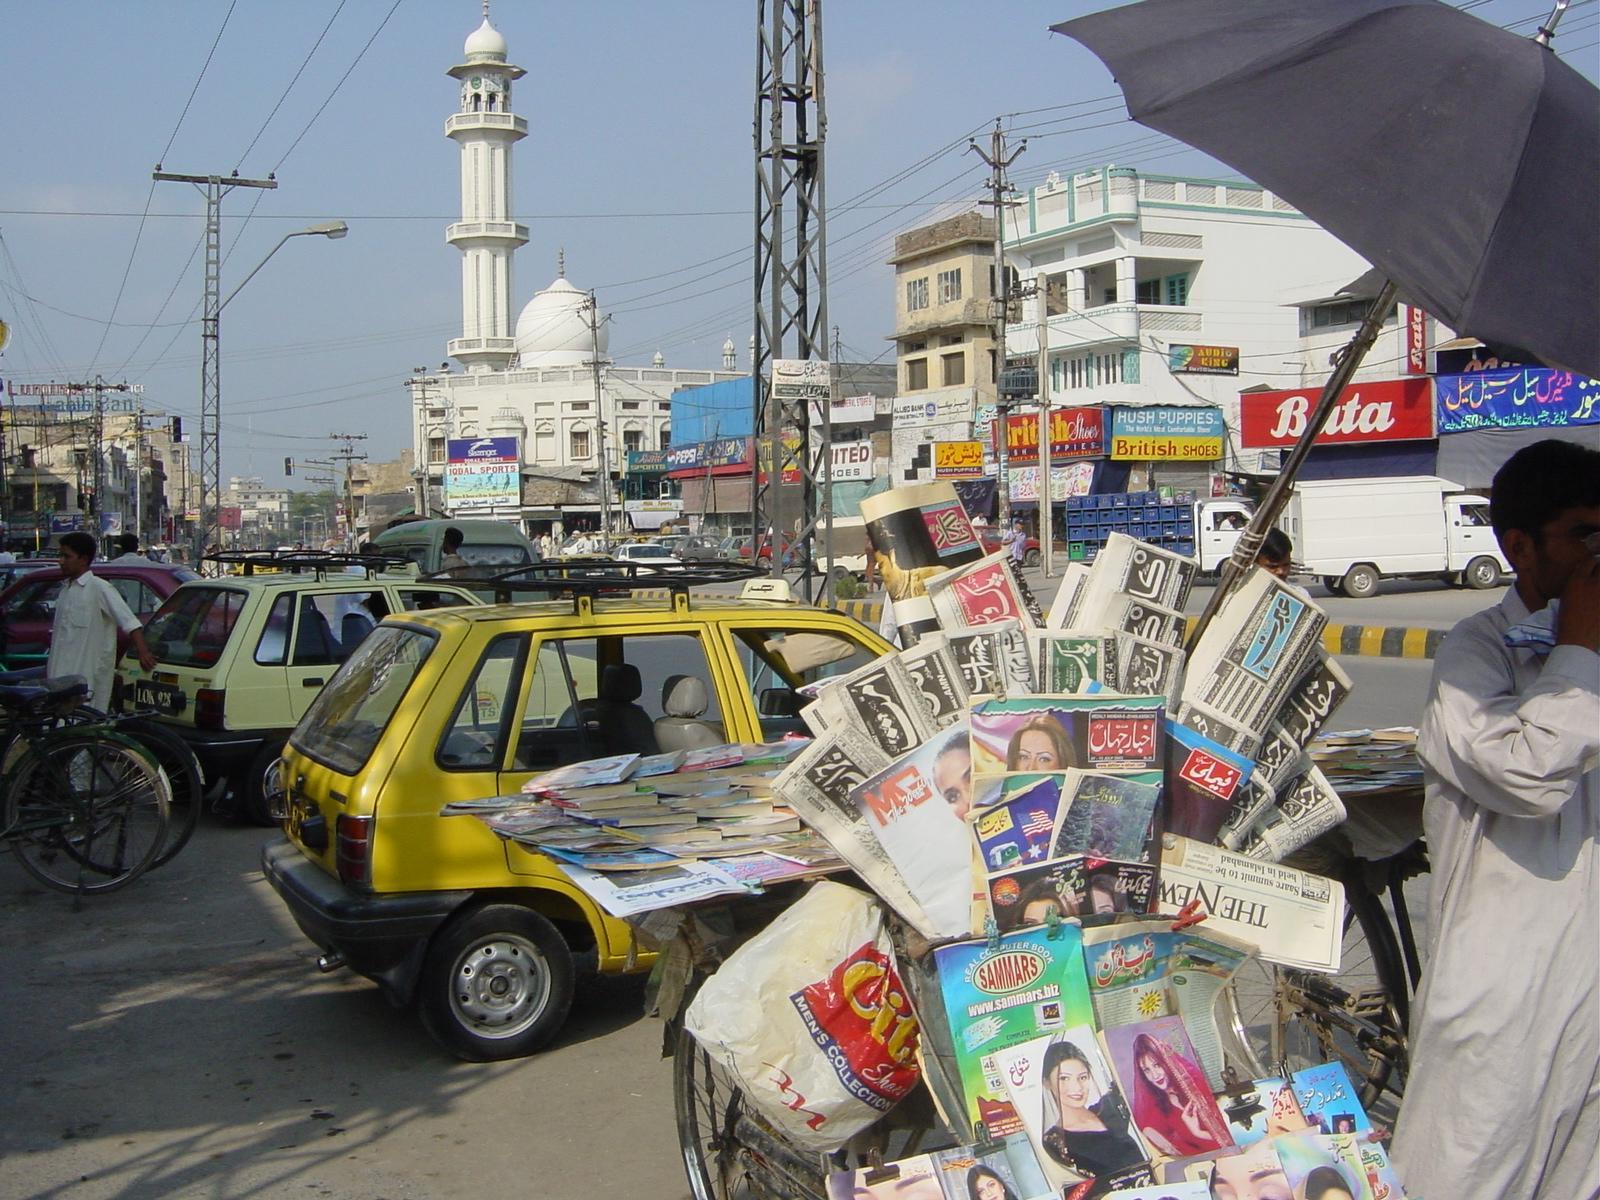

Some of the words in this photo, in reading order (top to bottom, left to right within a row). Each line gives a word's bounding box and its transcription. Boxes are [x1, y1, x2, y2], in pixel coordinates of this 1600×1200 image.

[1410, 308, 1424, 369] Bata
[1117, 411, 1155, 424] HUSH
[1159, 411, 1214, 425] PUPPIES
[993, 413, 1069, 447] ritsh
[1068, 412, 1099, 441] Shoes
[1116, 439, 1177, 456] British
[1183, 445, 1218, 456] SHOES
[676, 448, 697, 465] PEPSI
[449, 467, 475, 475] IQBAL
[480, 465, 516, 474] SPORTS
[1215, 866, 1227, 876] be
[1221, 855, 1266, 875] Islamabad
[1229, 868, 1239, 879] to
[1267, 866, 1278, 877] in
[1240, 872, 1277, 889] summit
[1280, 869, 1298, 882] held
[1219, 895, 1270, 929] THE
[979, 941, 1030, 961] COPUTER
[1031, 943, 1056, 964] BOOK
[979, 954, 1038, 991] SAMMARS
[967, 983, 1061, 1017] www.sammars.biz
[795, 996, 831, 1046] MEN'S
[828, 1045, 891, 1113] COLLECTION
